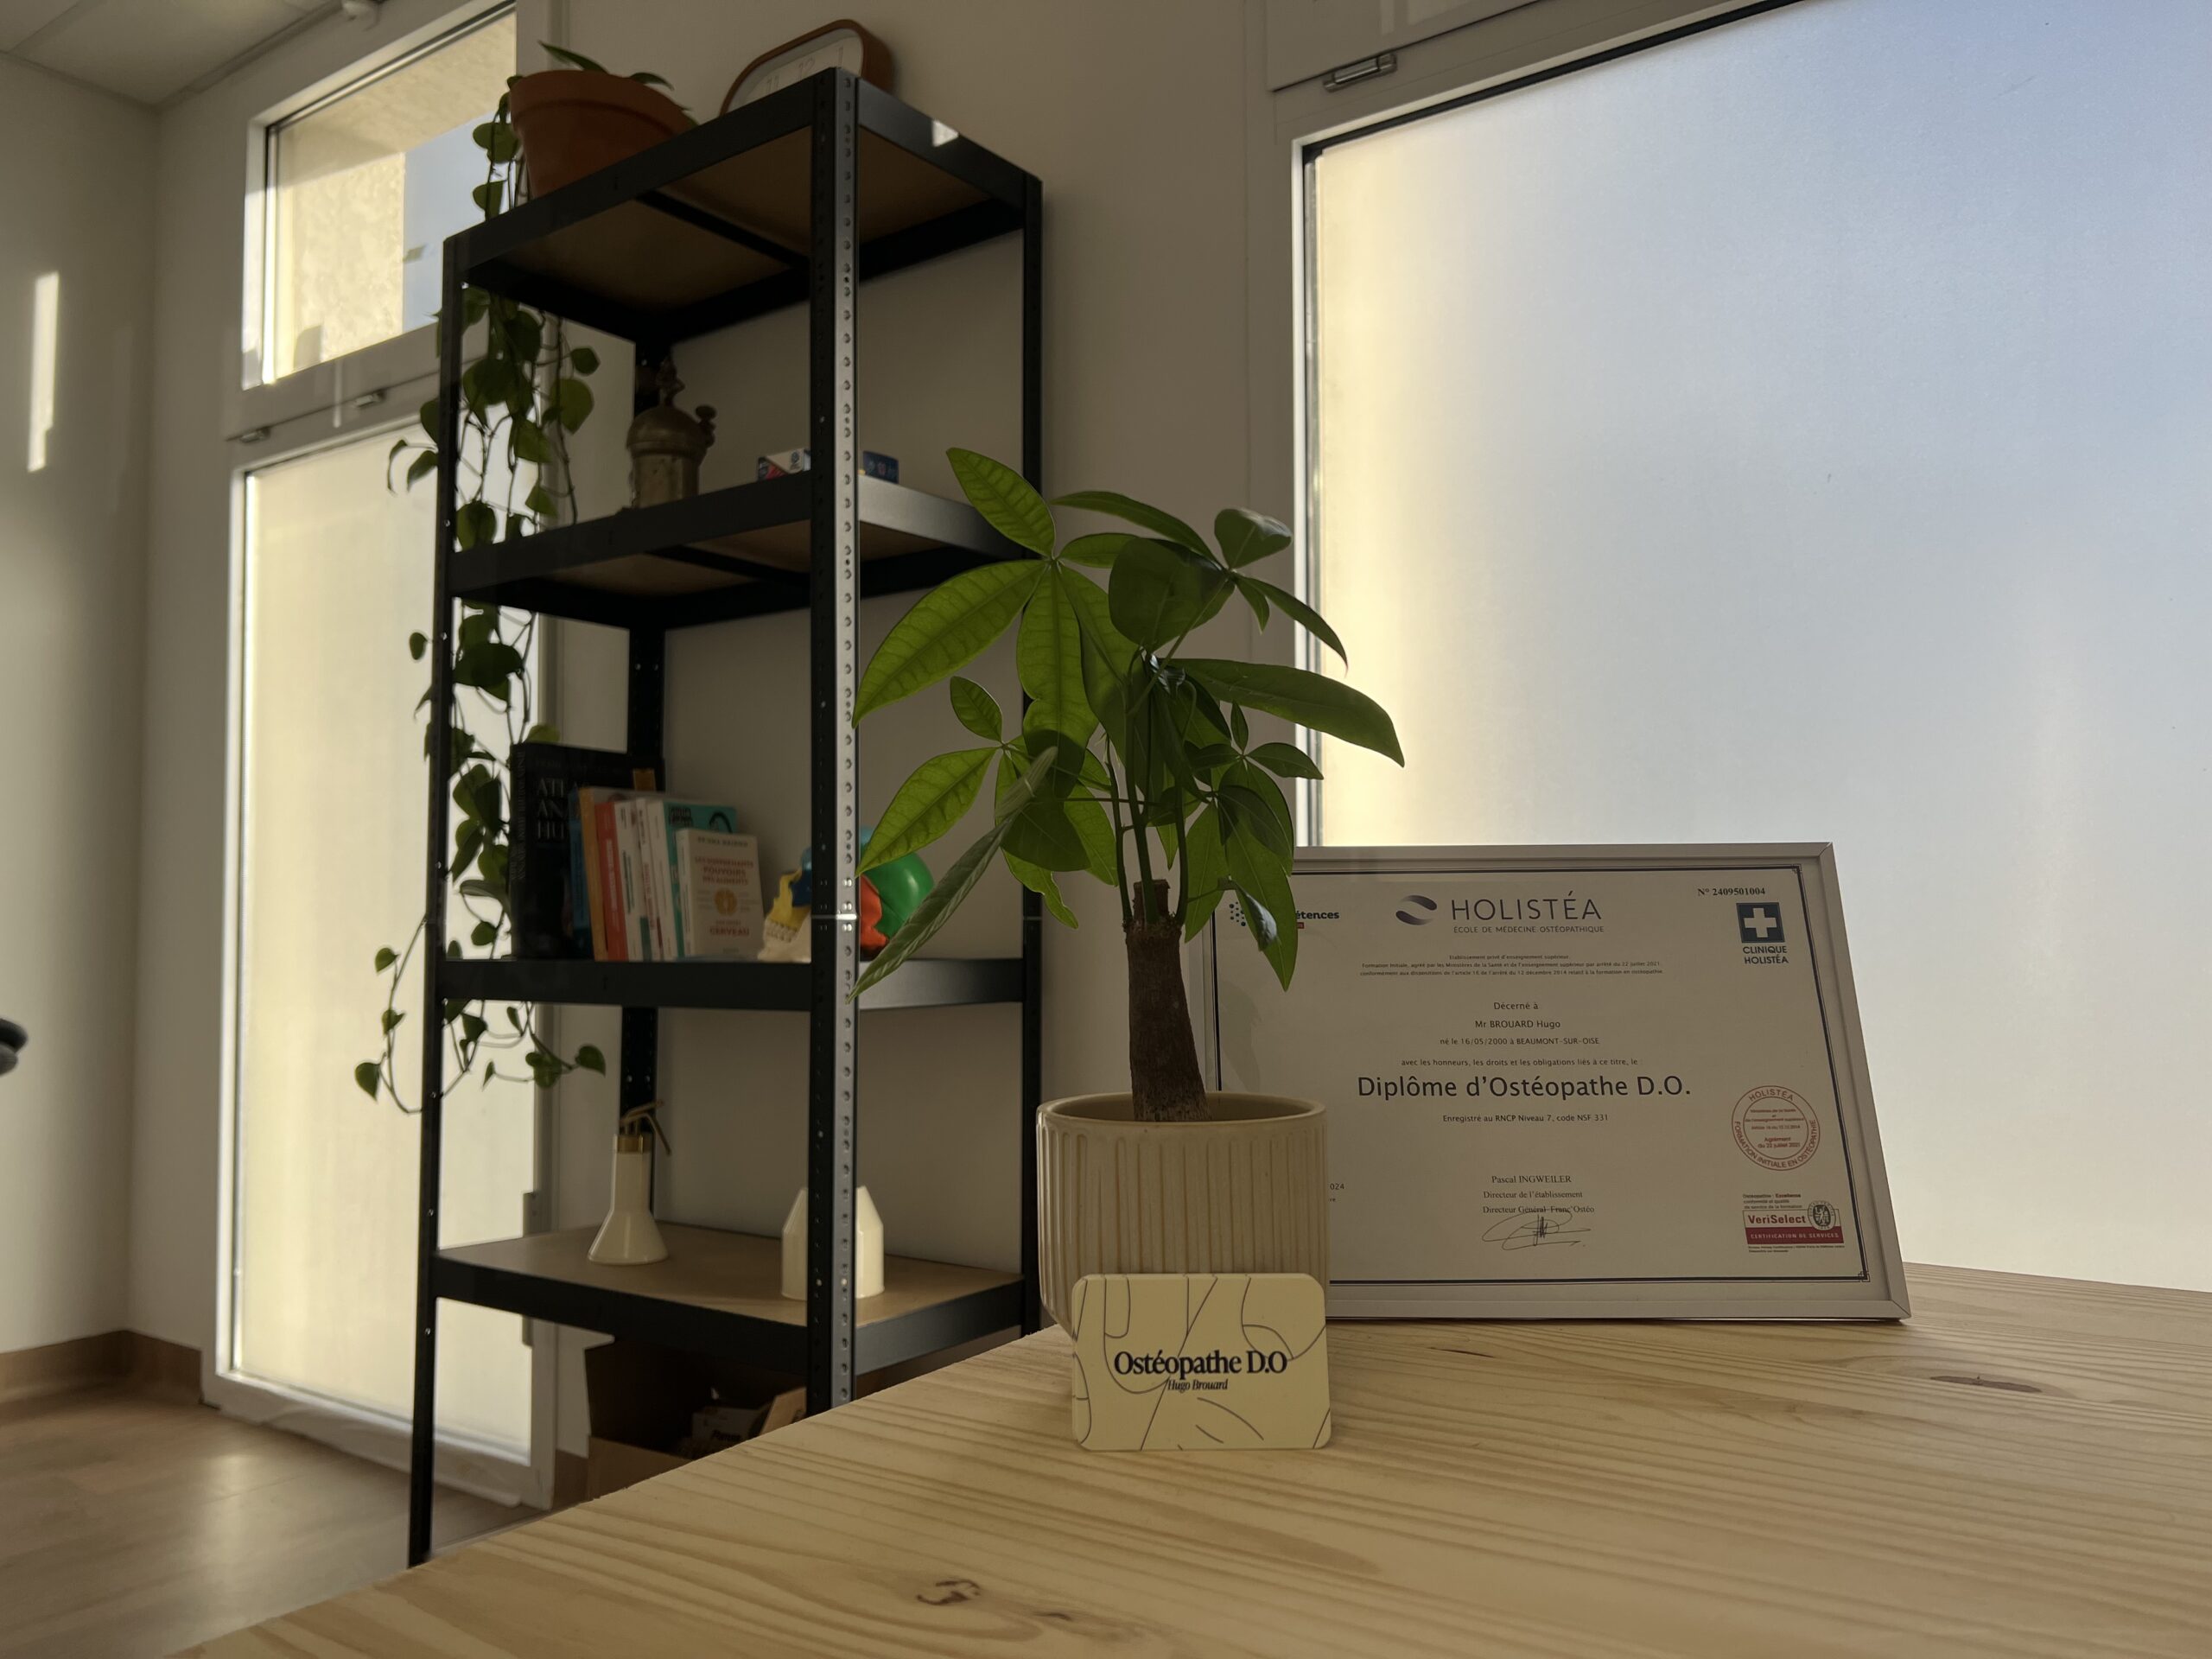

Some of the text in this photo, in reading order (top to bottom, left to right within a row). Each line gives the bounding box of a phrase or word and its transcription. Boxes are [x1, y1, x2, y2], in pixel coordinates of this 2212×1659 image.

[1712, 887, 1766, 896] 2409501004
[1452, 891, 1601, 920] HOLISTÉA
[1296, 911, 1339, 919] étences
[709, 927, 750, 937] CERVEAU
[1540, 925, 1605, 933] OSTÉOPATHIQUE
[1743, 945, 1788, 956] CLINIQUE
[1745, 954, 1789, 964] HOLISTÉA
[1493, 1001, 1539, 1010] Décerné à
[1474, 1020, 1561, 1030] Mr BROUARD Hugo
[1516, 1037, 1600, 1046] BEAUMONT-SUR-OISE
[1433, 1058, 1471, 1067] honneurs,
[1532, 1058, 1576, 1068] obligations
[1358, 1075, 1691, 1100] Diplôme d'Ostéopathe D.O.
[1442, 1115, 1482, 1124] Enregistré
[1495, 1114, 1516, 1122] RNCP
[1556, 1114, 1575, 1122] code
[1491, 1175, 1573, 1184] Pascal INGWEILER
[1329, 1182, 1345, 1191] 024
[1483, 1191, 1517, 1199] Directeur
[1529, 1190, 1583, 1198] l'établissement
[1483, 1205, 1516, 1214] Directeur
[1748, 1215, 1806, 1224] VeriSelect
[1114, 1349, 1287, 1380] Ostéopathe D.O
[1167, 1379, 1228, 1393] Hugo Brouard
